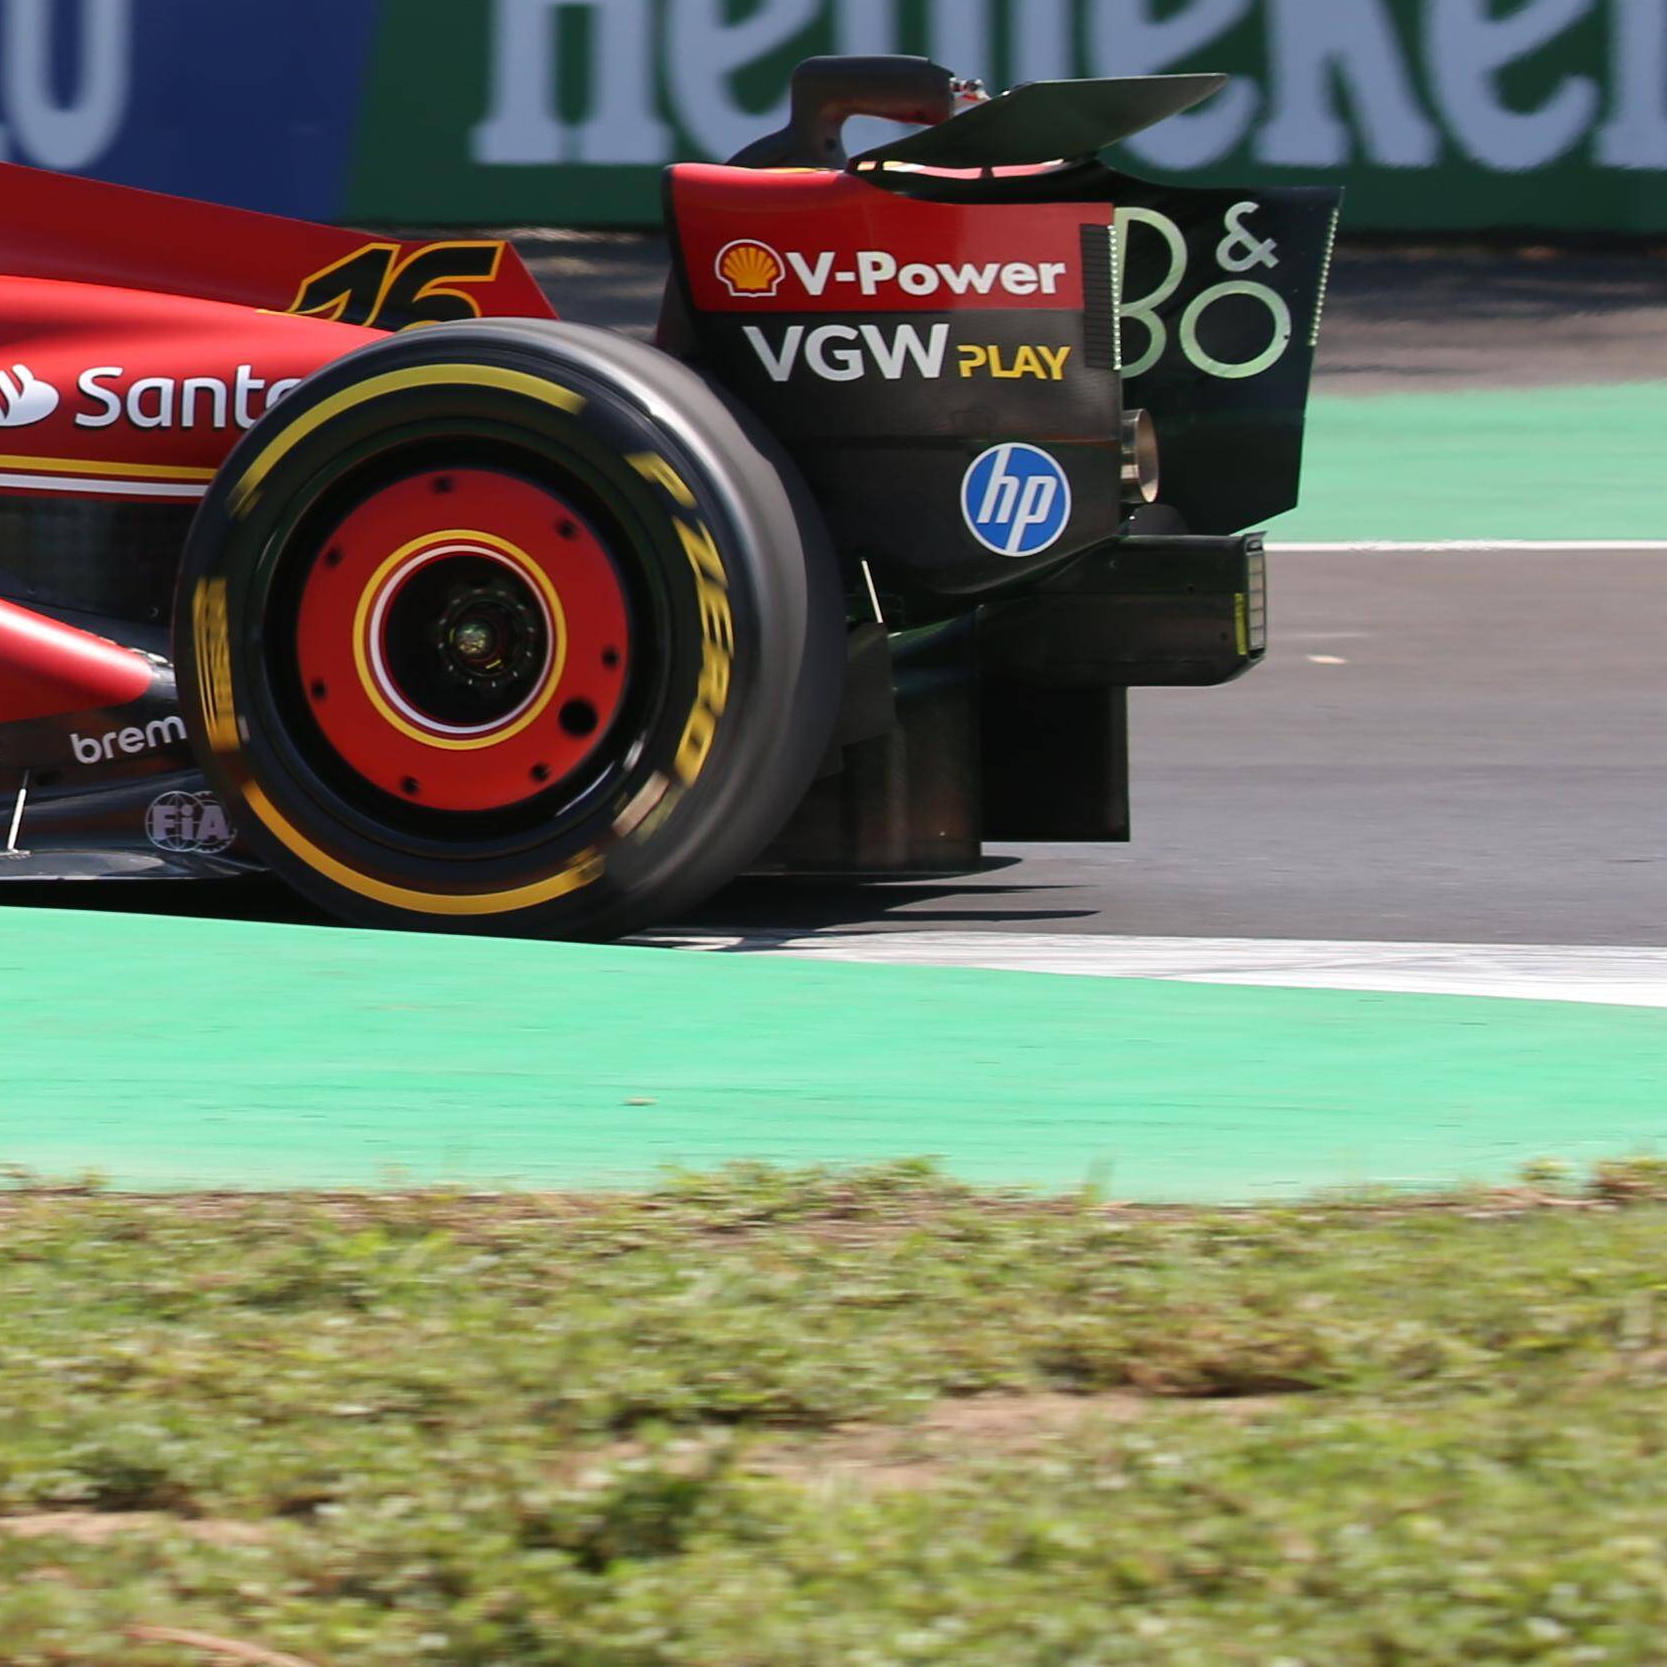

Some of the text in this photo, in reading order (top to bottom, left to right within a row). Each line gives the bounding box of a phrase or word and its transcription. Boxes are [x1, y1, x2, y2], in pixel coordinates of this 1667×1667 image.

[279, 240, 506, 332] 16
[786, 250, 1066, 296] V-Power
[742, 323, 1072, 383] VGW PLAY
[976, 445, 1058, 555] hp
